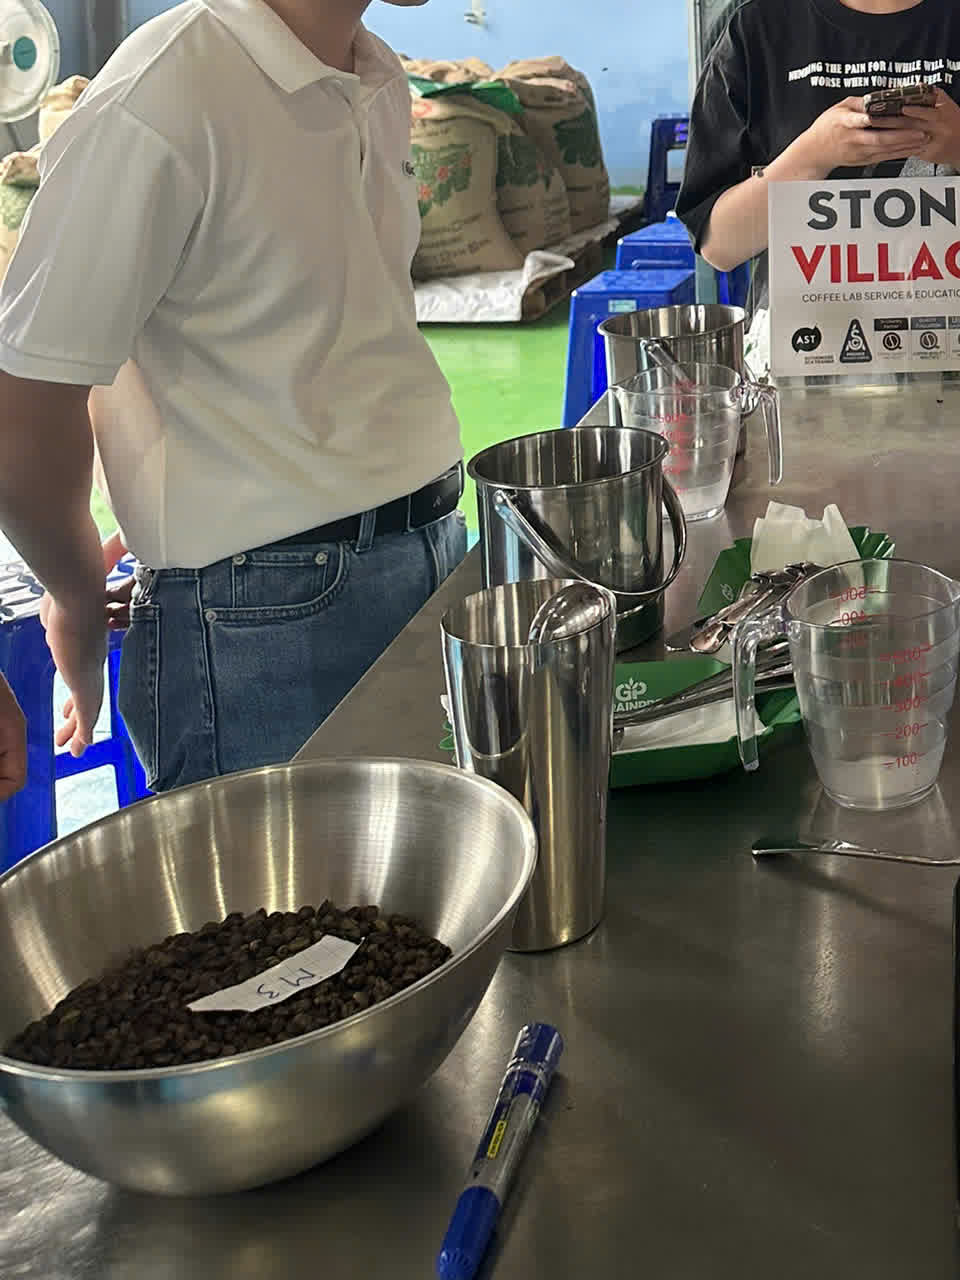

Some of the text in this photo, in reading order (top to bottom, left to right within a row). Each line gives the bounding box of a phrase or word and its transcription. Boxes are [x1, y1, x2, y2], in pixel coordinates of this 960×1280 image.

[826, 63, 842, 74] THE
[845, 62, 866, 74] PAIN
[867, 60, 886, 74] FOR
[895, 60, 921, 74] WHILE
[923, 59, 944, 72] WILL
[810, 75, 841, 88] WORSE
[843, 76, 869, 88] WHEN
[871, 75, 887, 88] YOU
[888, 74, 921, 89] FINALLY
[923, 73, 943, 85] FEEL
[802, 293, 841, 303] COFFEE
[842, 292, 862, 301] LAB
[864, 290, 904, 301] SERVICE
[796, 335, 816, 345] AST
[895, 722, 920, 740] 200
[895, 751, 918, 769] 100
